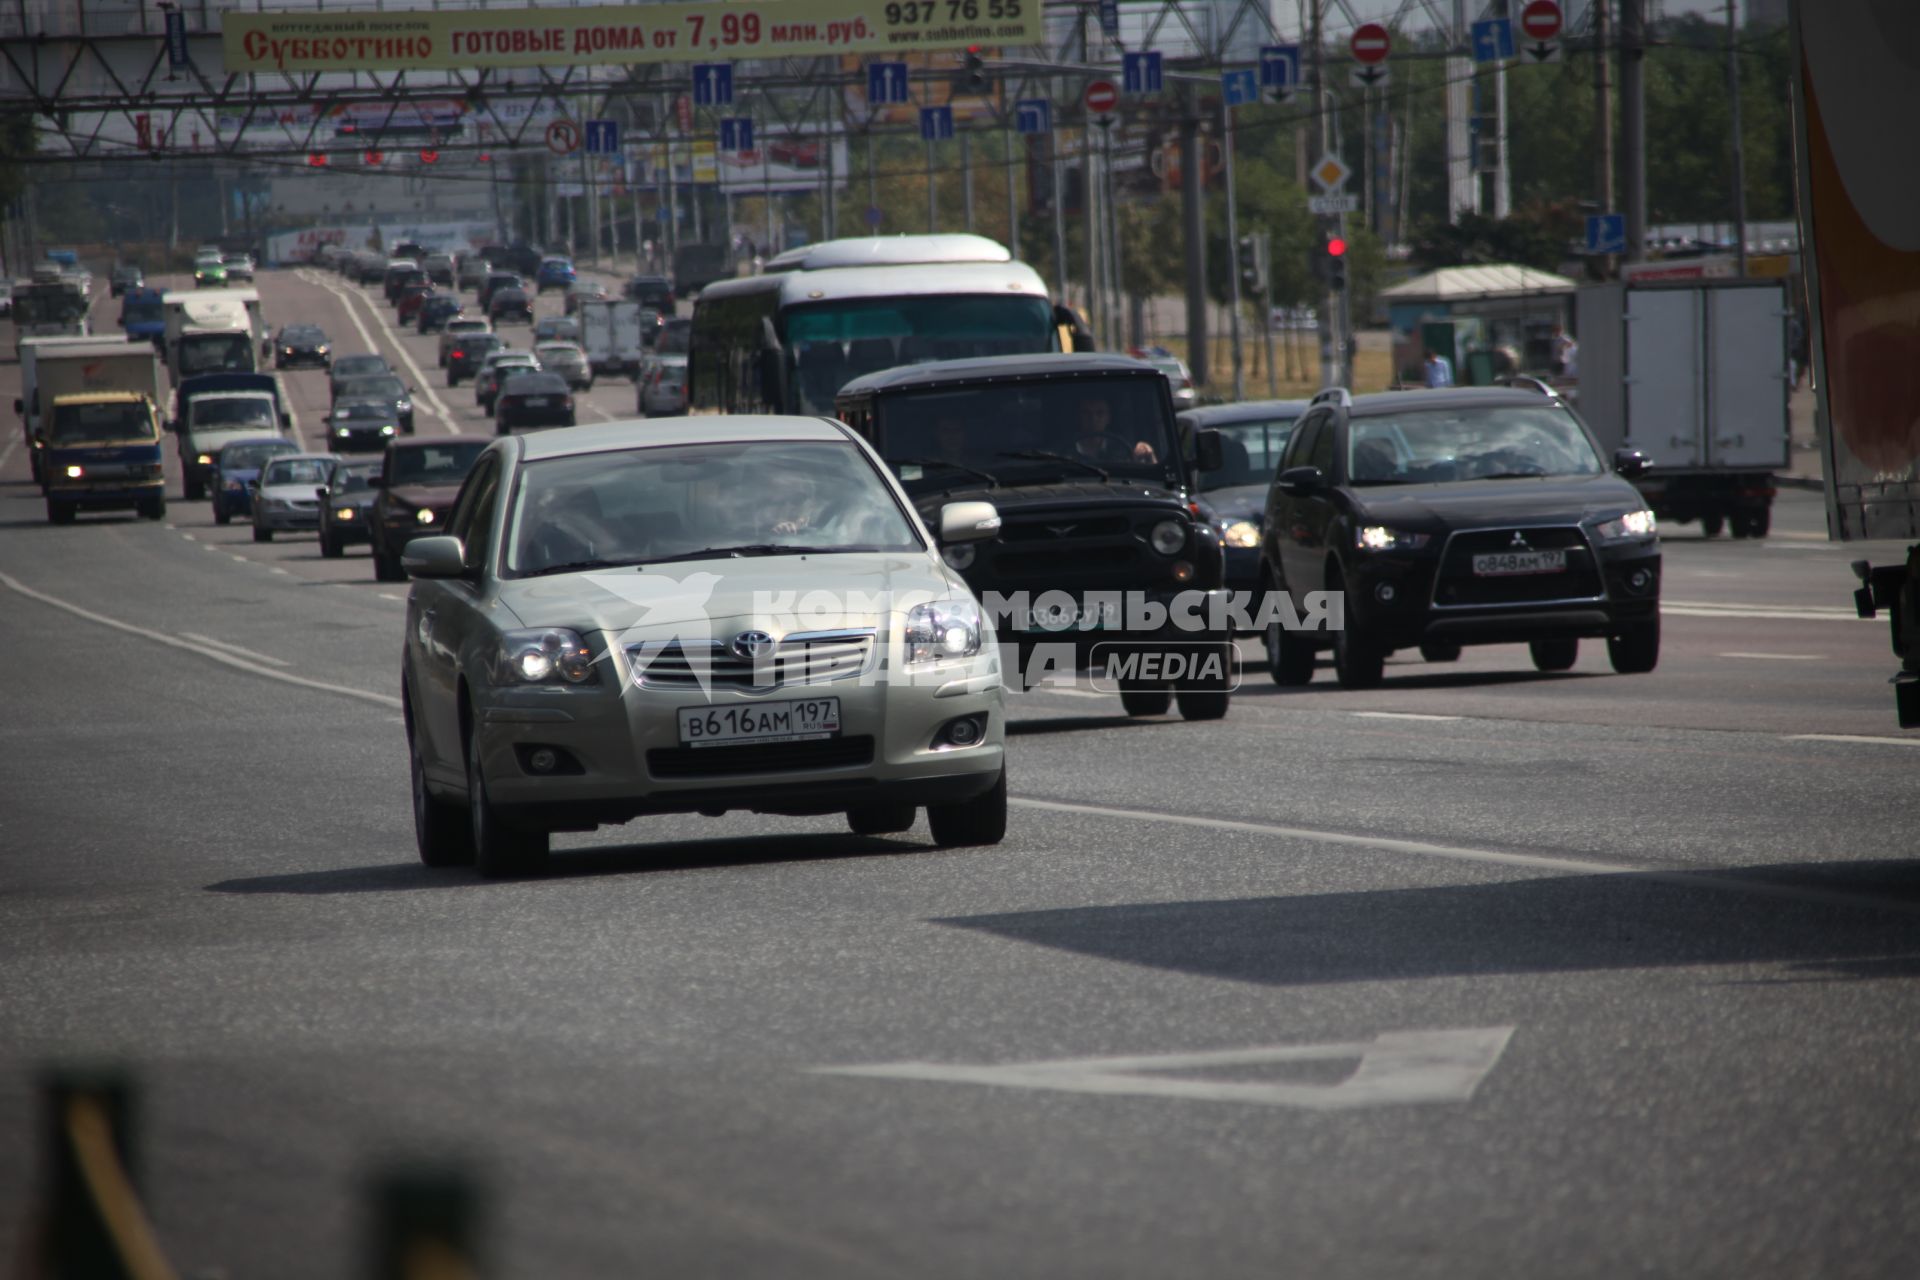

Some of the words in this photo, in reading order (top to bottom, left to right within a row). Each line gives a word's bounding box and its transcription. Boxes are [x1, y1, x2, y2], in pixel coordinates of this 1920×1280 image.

[885, 1, 936, 25] 937
[945, 0, 979, 21] 76
[987, 0, 1022, 19] 55
[452, 28, 566, 55] ГОТОВЫЕ
[574, 25, 645, 55] ДОМА
[652, 30, 677, 48] от
[686, 12, 761, 51] 7,99
[795, 701, 831, 722] 197
